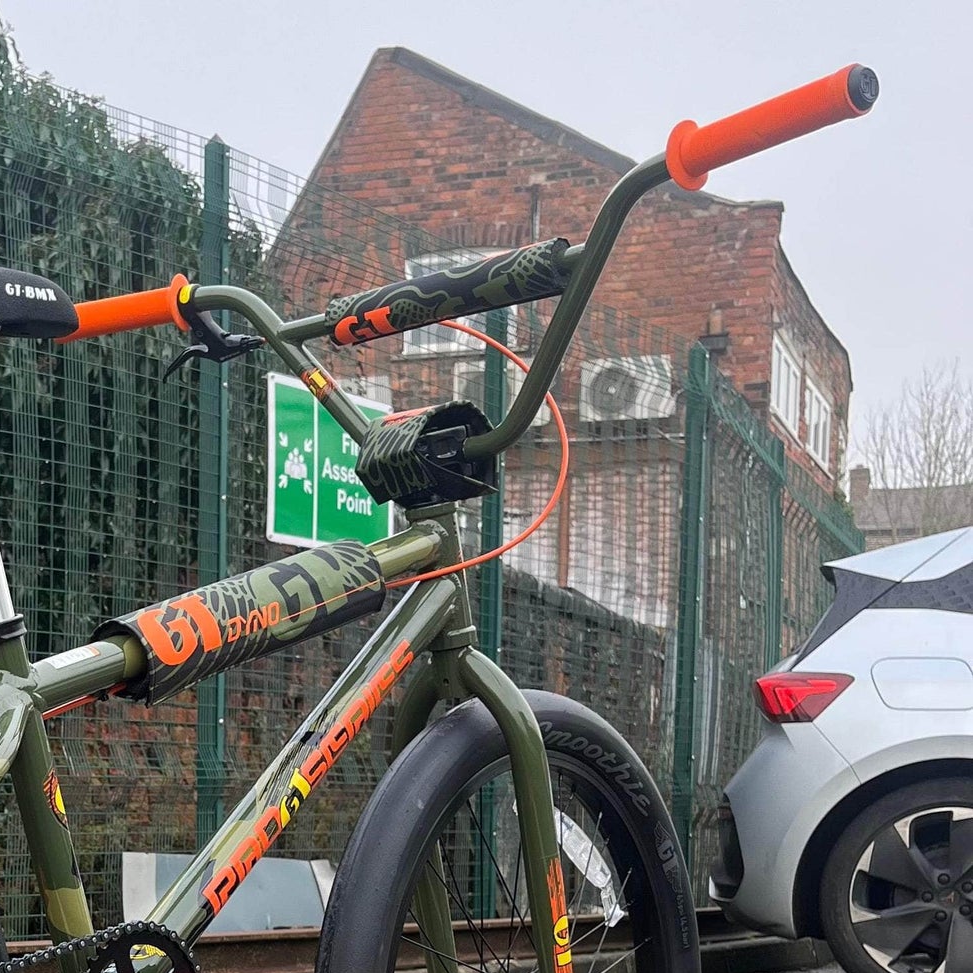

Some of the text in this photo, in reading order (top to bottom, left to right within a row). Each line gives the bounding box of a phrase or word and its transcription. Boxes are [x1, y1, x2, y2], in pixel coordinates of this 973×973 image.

[334, 305, 396, 346] GT
[337, 488, 372, 516] Point
[137, 594, 223, 666] GT
[226, 601, 281, 643] DYNO
[299, 639, 415, 791] SERIES
